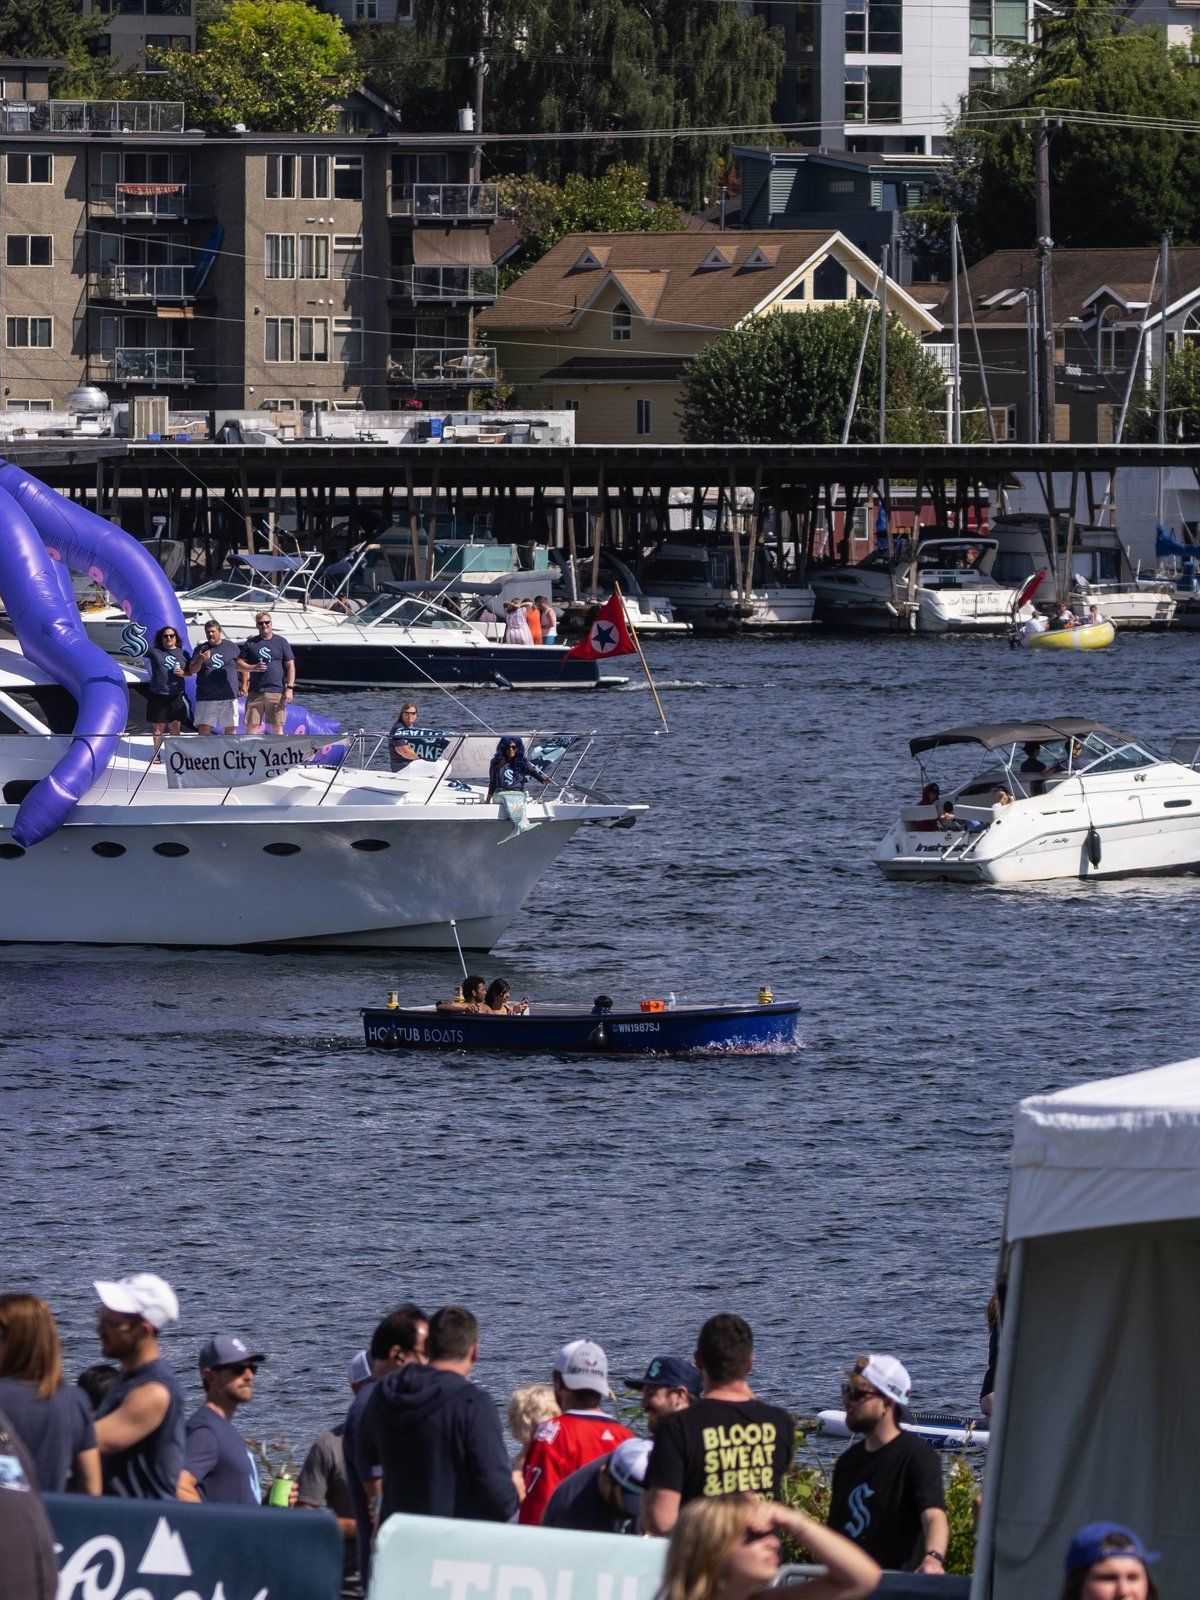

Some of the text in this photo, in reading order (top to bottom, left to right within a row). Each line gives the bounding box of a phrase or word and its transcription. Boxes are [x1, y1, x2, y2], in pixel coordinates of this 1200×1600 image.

[170, 747, 304, 776] Queen City Yacht
[368, 1026, 464, 1043] HO TUB BOATS
[702, 1422, 777, 1451] BLOOD
[703, 1443, 776, 1474] SWEAT
